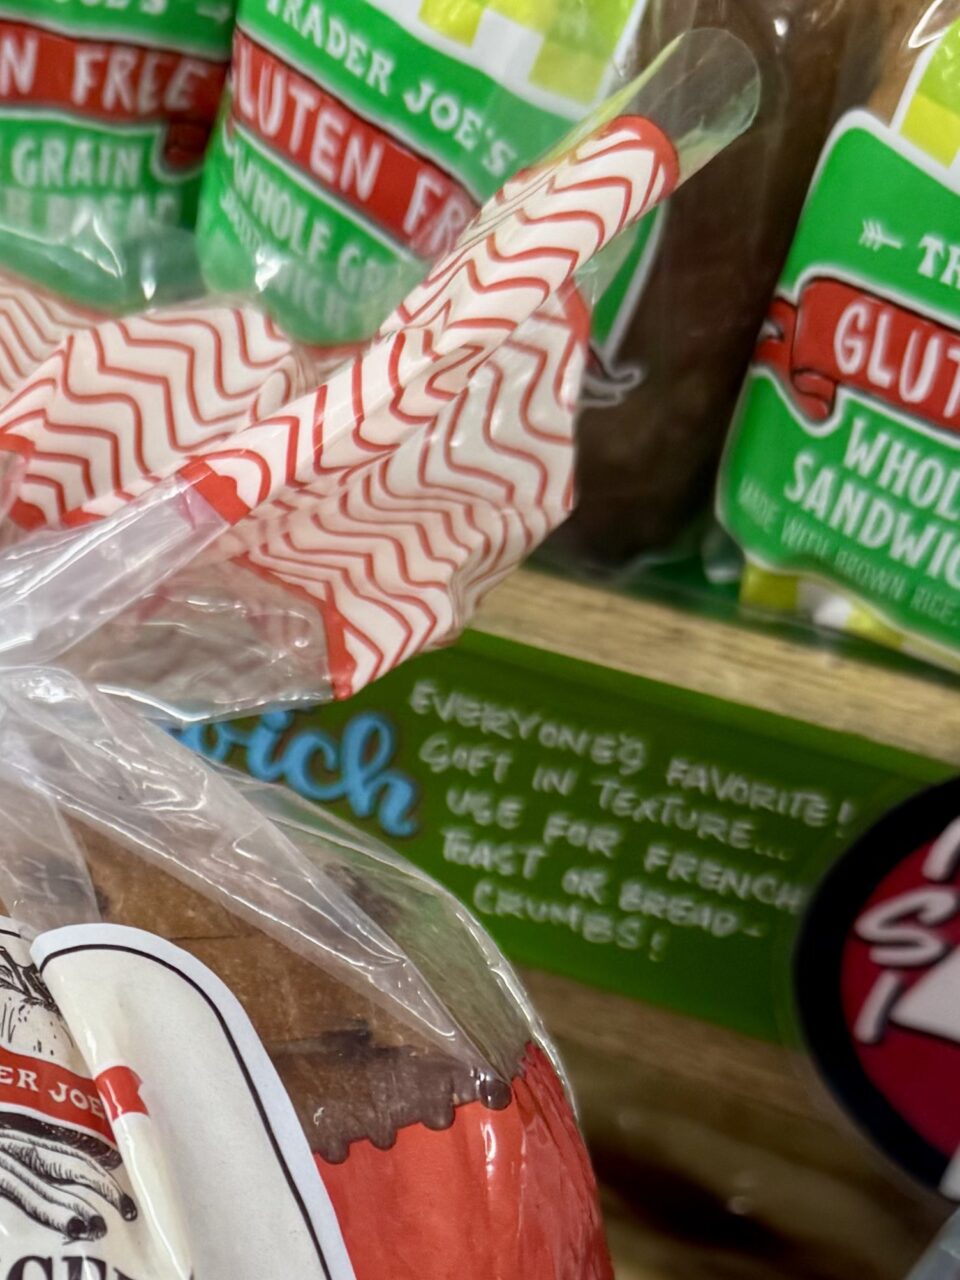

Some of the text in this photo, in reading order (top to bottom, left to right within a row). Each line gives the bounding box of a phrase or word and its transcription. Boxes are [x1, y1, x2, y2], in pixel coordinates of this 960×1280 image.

[71, 49, 209, 112] FREE
[232, 46, 384, 201] LUTEN
[403, 81, 517, 177] JOE'S
[11, 136, 142, 190] GRAIN
[532, 766, 580, 798] IN
[444, 786, 525, 830] USE
[542, 812, 624, 859] FOR
[441, 826, 547, 881] TOAST
[561, 867, 611, 905] OR
[48, 1082, 106, 1118] JOE
